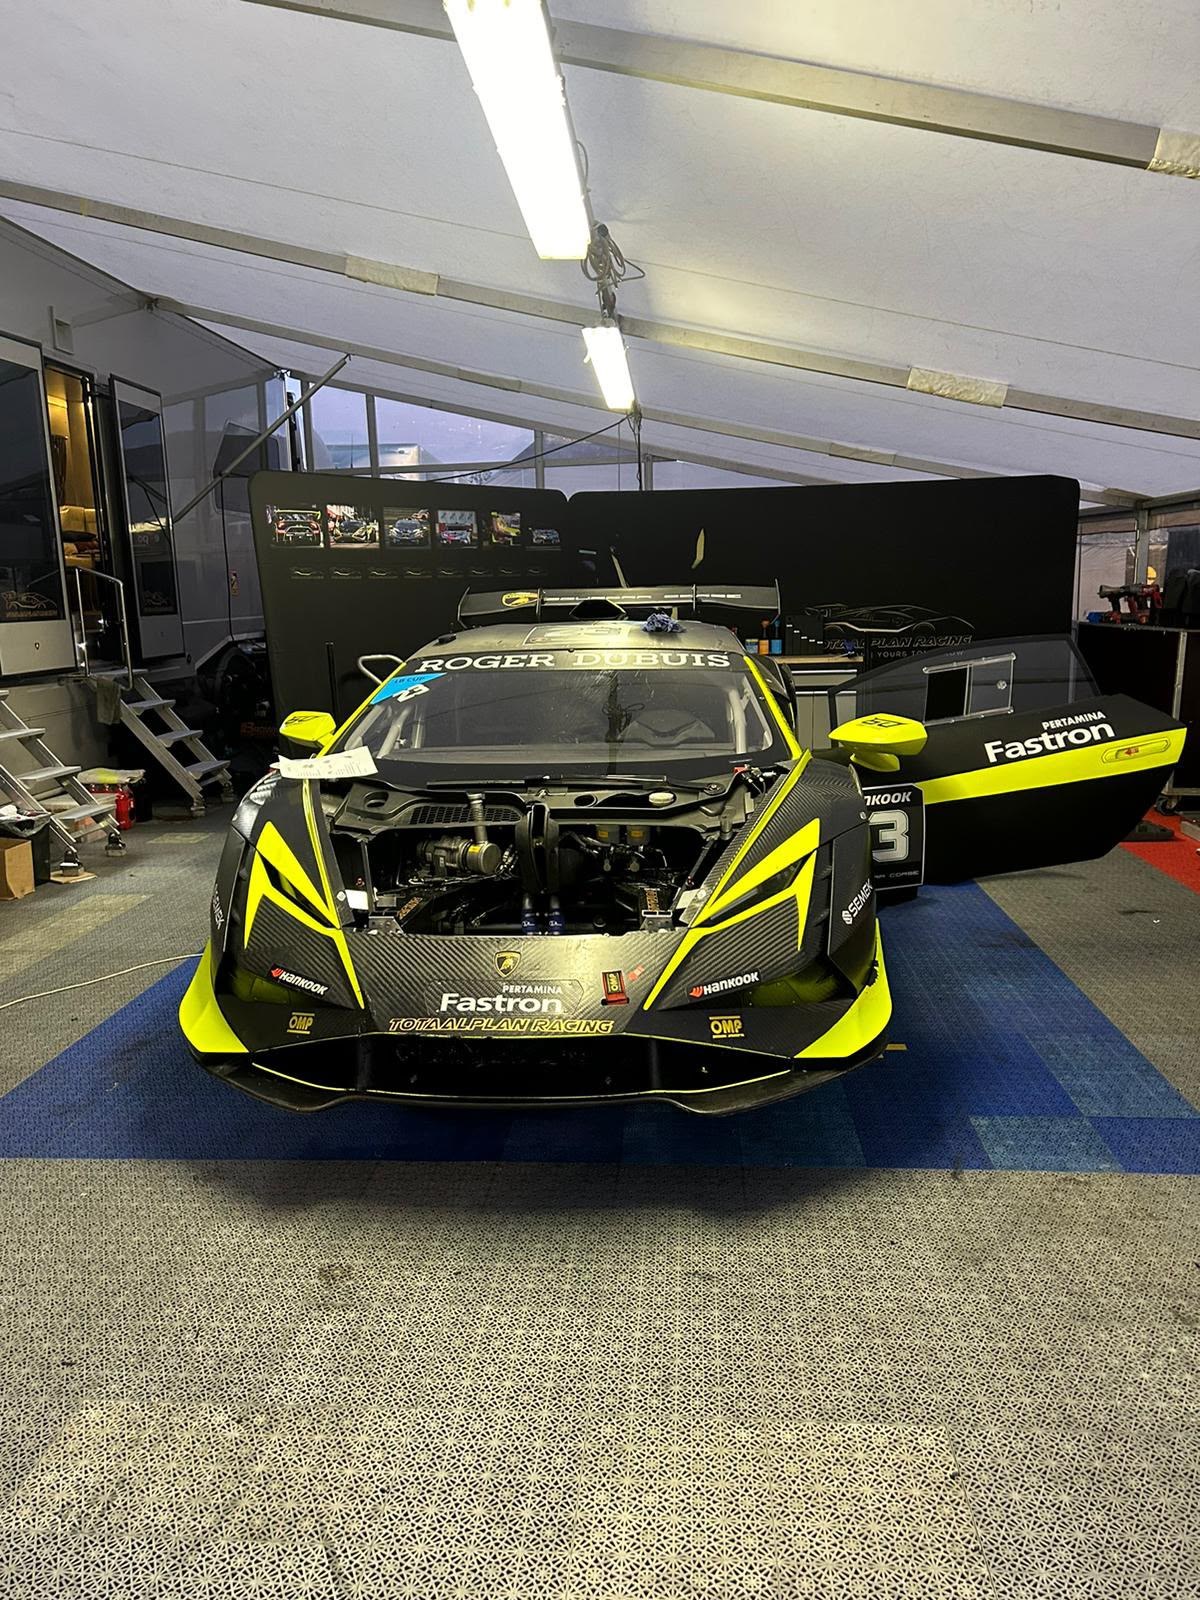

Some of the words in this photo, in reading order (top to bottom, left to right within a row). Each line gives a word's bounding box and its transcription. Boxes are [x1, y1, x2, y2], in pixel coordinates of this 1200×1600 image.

[912, 635, 973, 648] RACING
[415, 654, 555, 673] ROGER
[573, 652, 731, 668] DUBUIS
[392, 683, 430, 703] 23
[1041, 711, 1106, 730] PERTAMINA
[984, 722, 1115, 763] Fastron
[868, 809, 909, 862] 3
[848, 878, 873, 917] SEMEK
[502, 981, 563, 995] PERTAMINA
[439, 993, 562, 1012] Fastron
[288, 1015, 314, 1030] OMP
[389, 1017, 530, 1031] TOTAALPLAN
[531, 1018, 615, 1033] RACING
[710, 1019, 743, 1034] OMP
